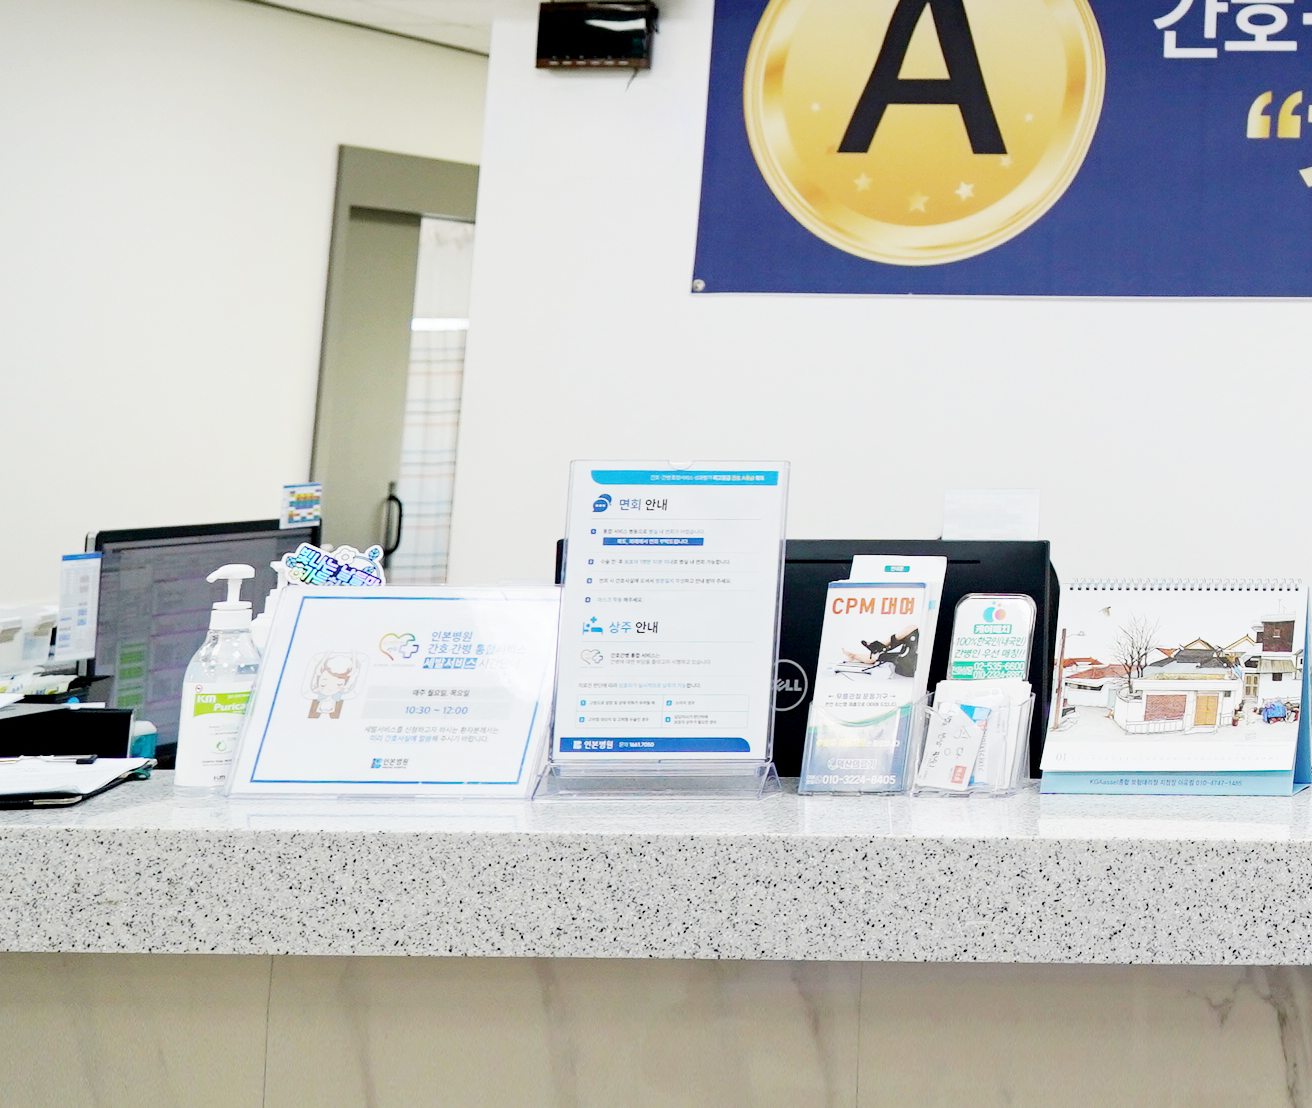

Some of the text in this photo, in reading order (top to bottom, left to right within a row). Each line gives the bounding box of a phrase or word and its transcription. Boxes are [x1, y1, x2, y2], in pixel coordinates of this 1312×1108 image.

[619, 498, 668, 511] 면회 안내
[831, 597, 915, 615] CPM 대여
[609, 621, 658, 633] 상주 안내
[431, 631, 473, 642] 인본병원
[954, 649, 981, 658] 간병인
[982, 649, 1000, 658] 우선
[776, 678, 802, 692] ELL
[405, 706, 431, 714] 10:30
[443, 706, 469, 714] 12:00
[584, 740, 613, 749] 인본병원
